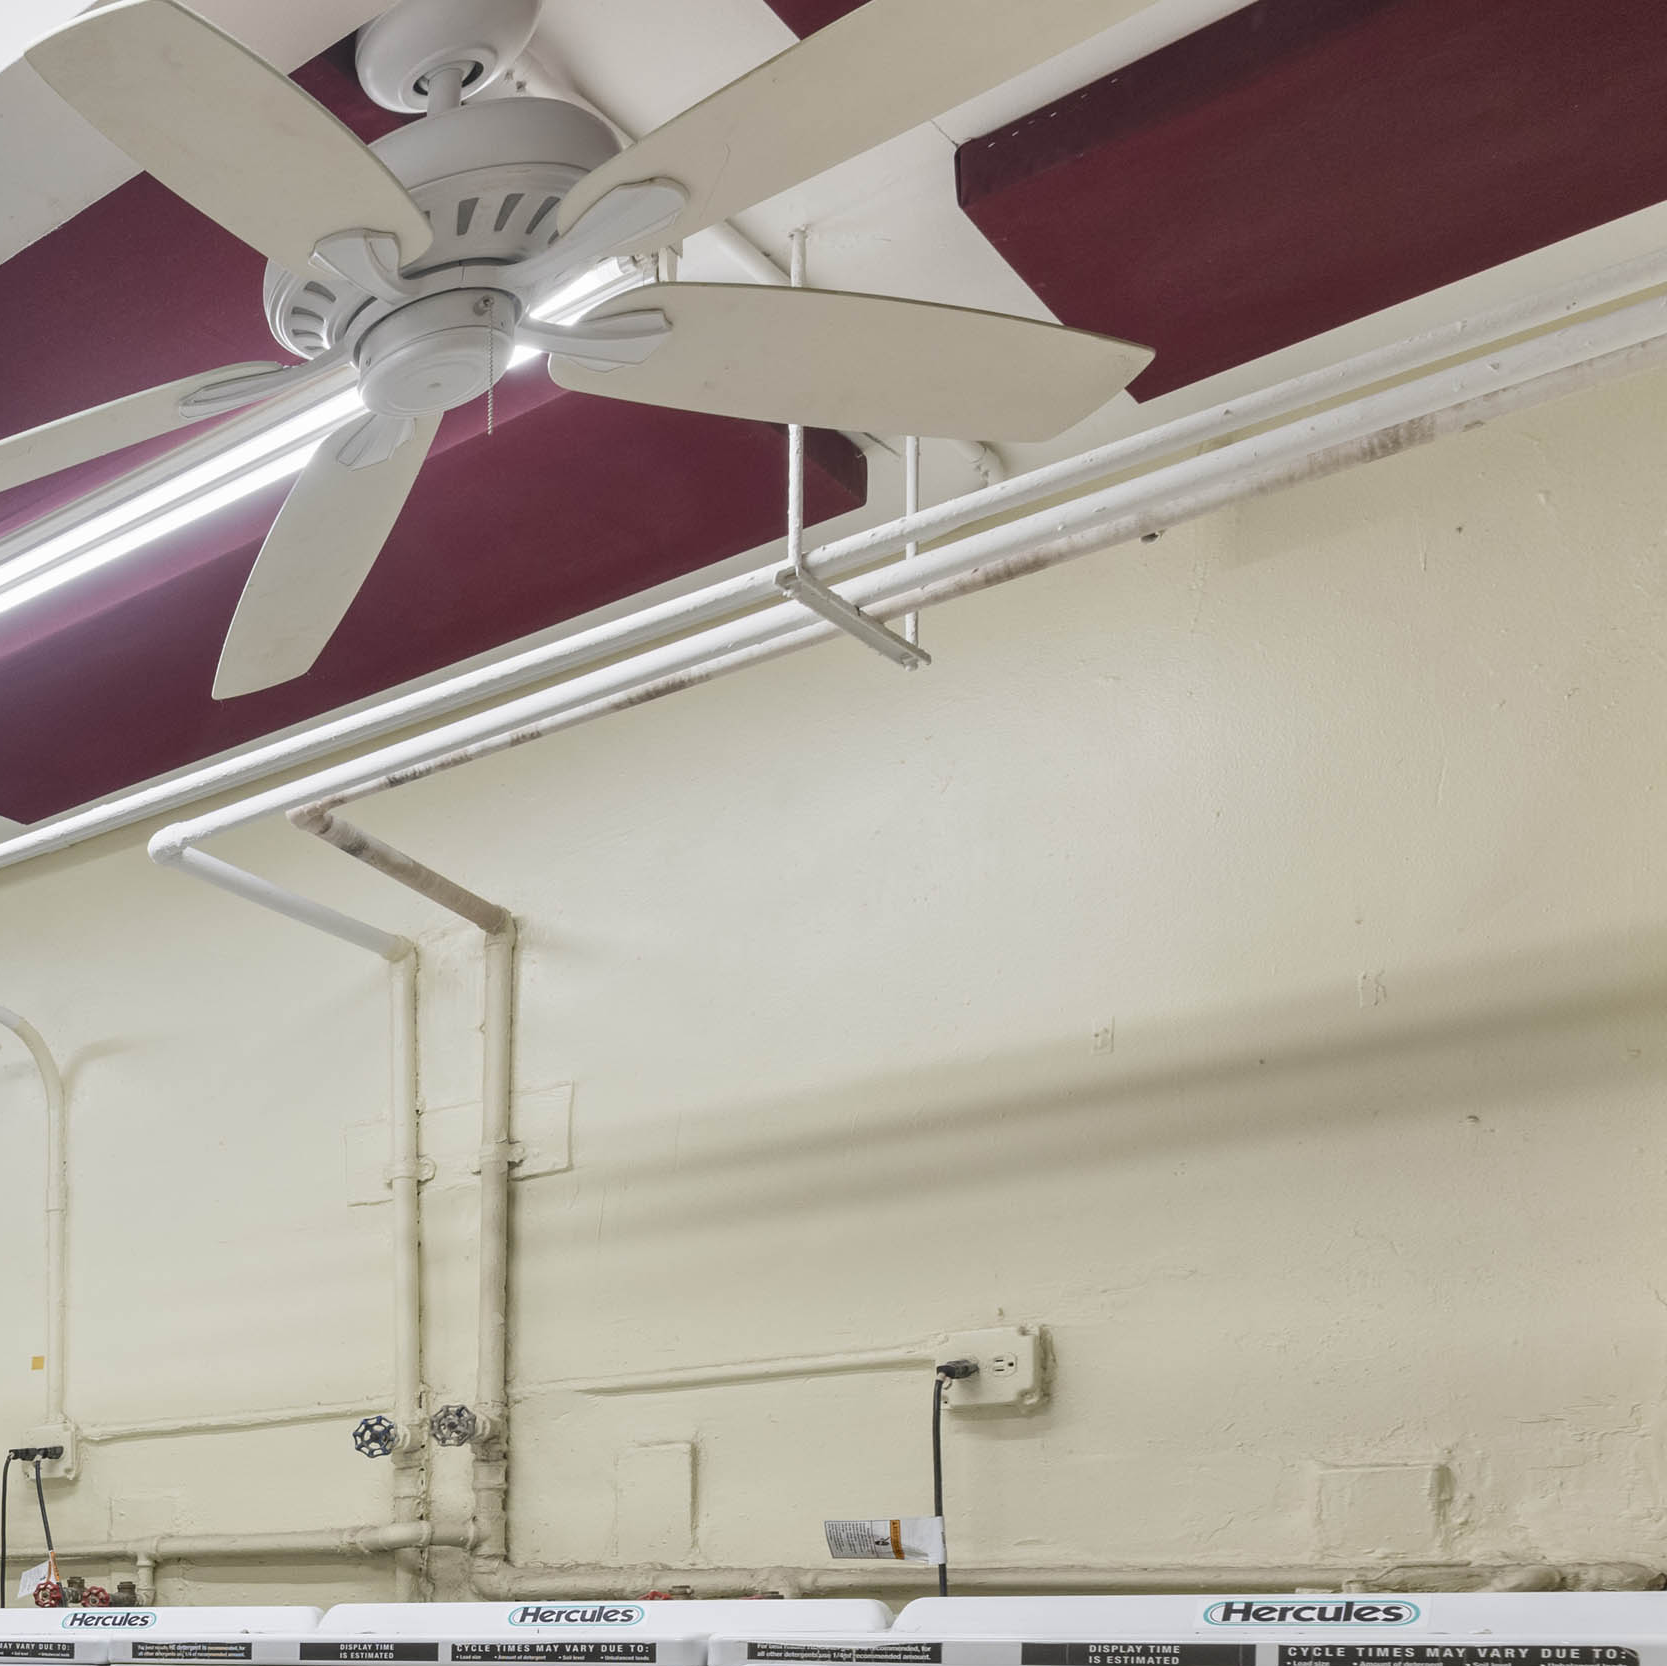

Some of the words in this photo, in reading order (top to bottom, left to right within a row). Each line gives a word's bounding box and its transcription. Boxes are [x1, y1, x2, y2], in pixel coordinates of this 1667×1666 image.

[520, 1607, 634, 1622] Hercules
[1222, 1602, 1403, 1622] Hercules
[69, 1613, 149, 1626] Hercules
[1089, 1645, 1142, 1653] DISPLAY
[1288, 1647, 1346, 1657] CYCLE
[1357, 1648, 1415, 1658] TIMES
[1426, 1649, 1465, 1658] MAY
[1477, 1649, 1528, 1658] VARY
[1541, 1649, 1580, 1659] DUE
[1594, 1649, 1627, 1659] TO:
[1107, 1656, 1179, 1665] ESTIMATED
